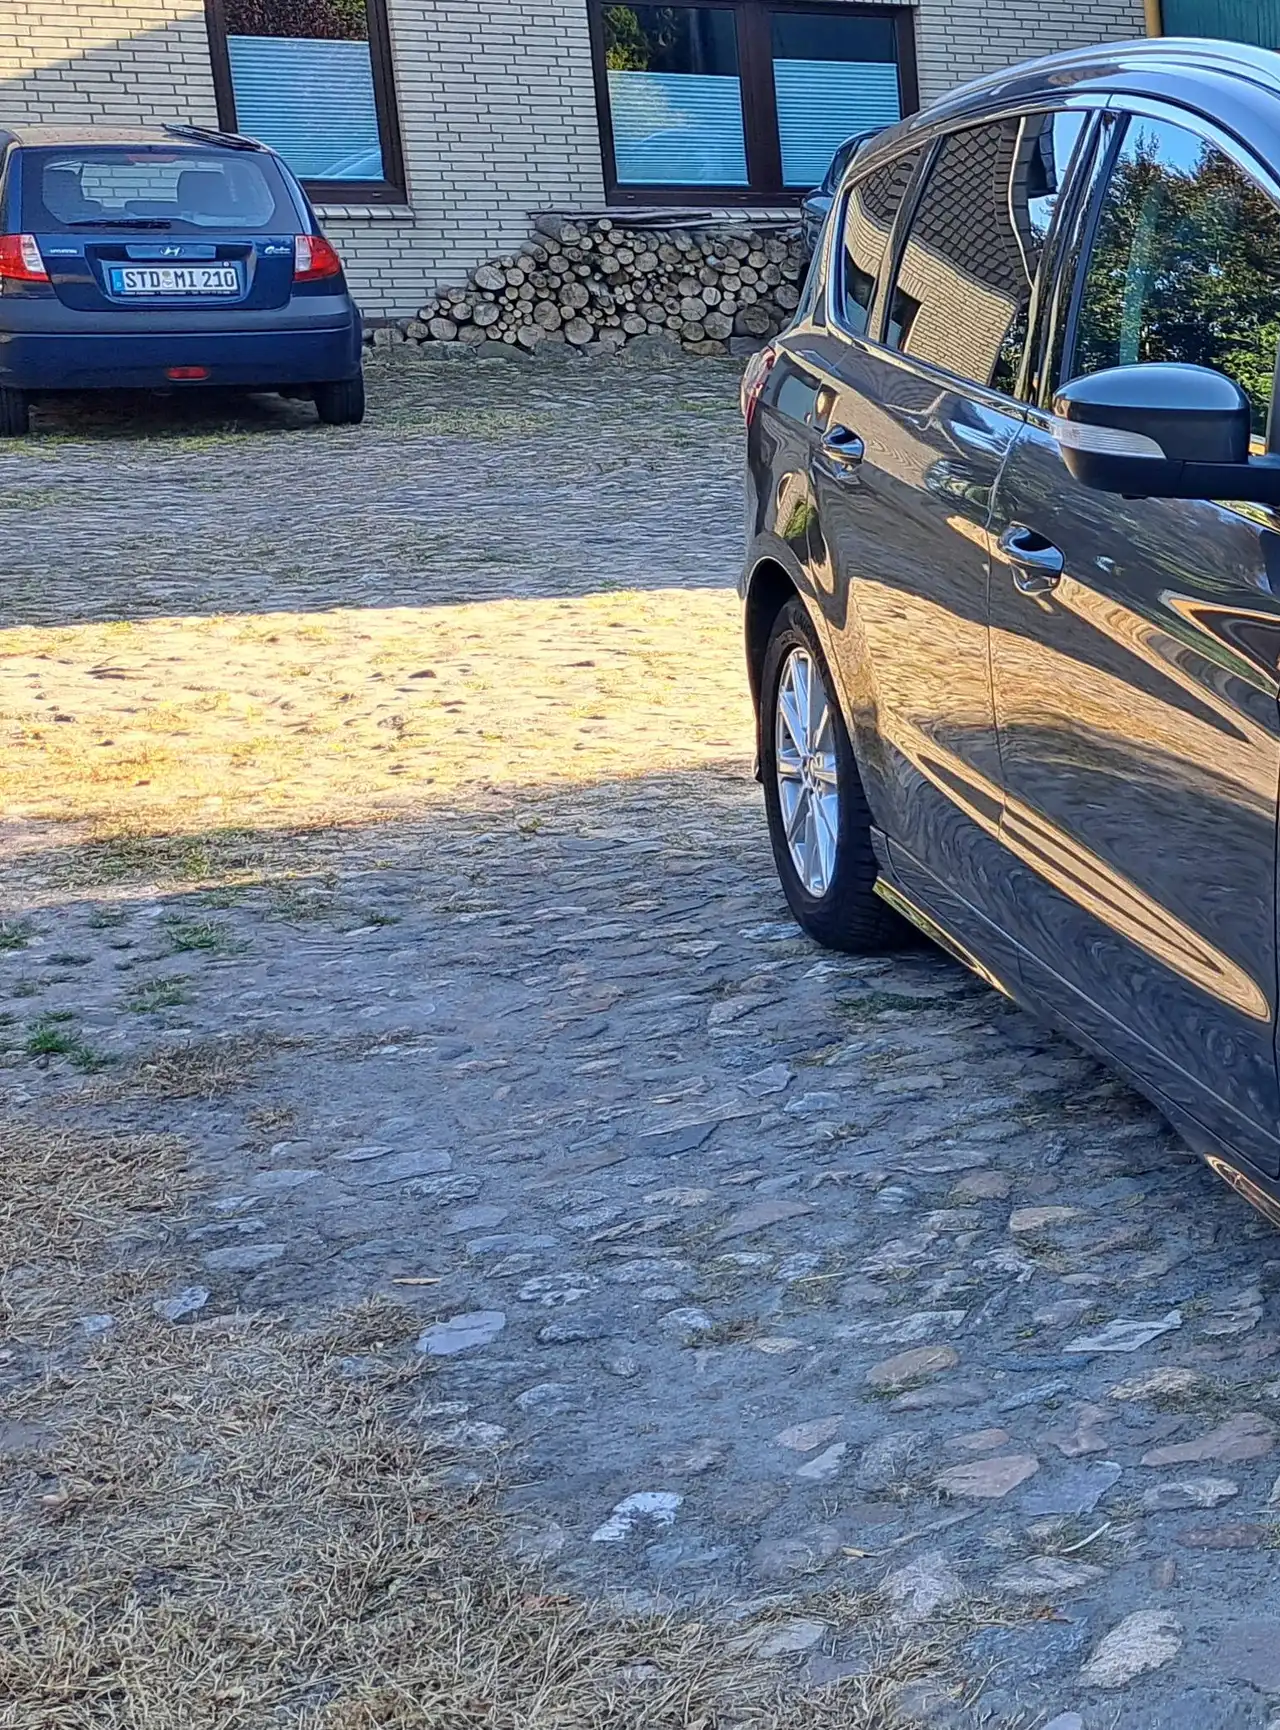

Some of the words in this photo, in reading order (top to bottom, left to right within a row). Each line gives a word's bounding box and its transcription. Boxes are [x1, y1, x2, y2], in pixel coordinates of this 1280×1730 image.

[125, 270, 160, 288] STD
[173, 270, 197, 288] MI
[201, 270, 235, 288] 210
